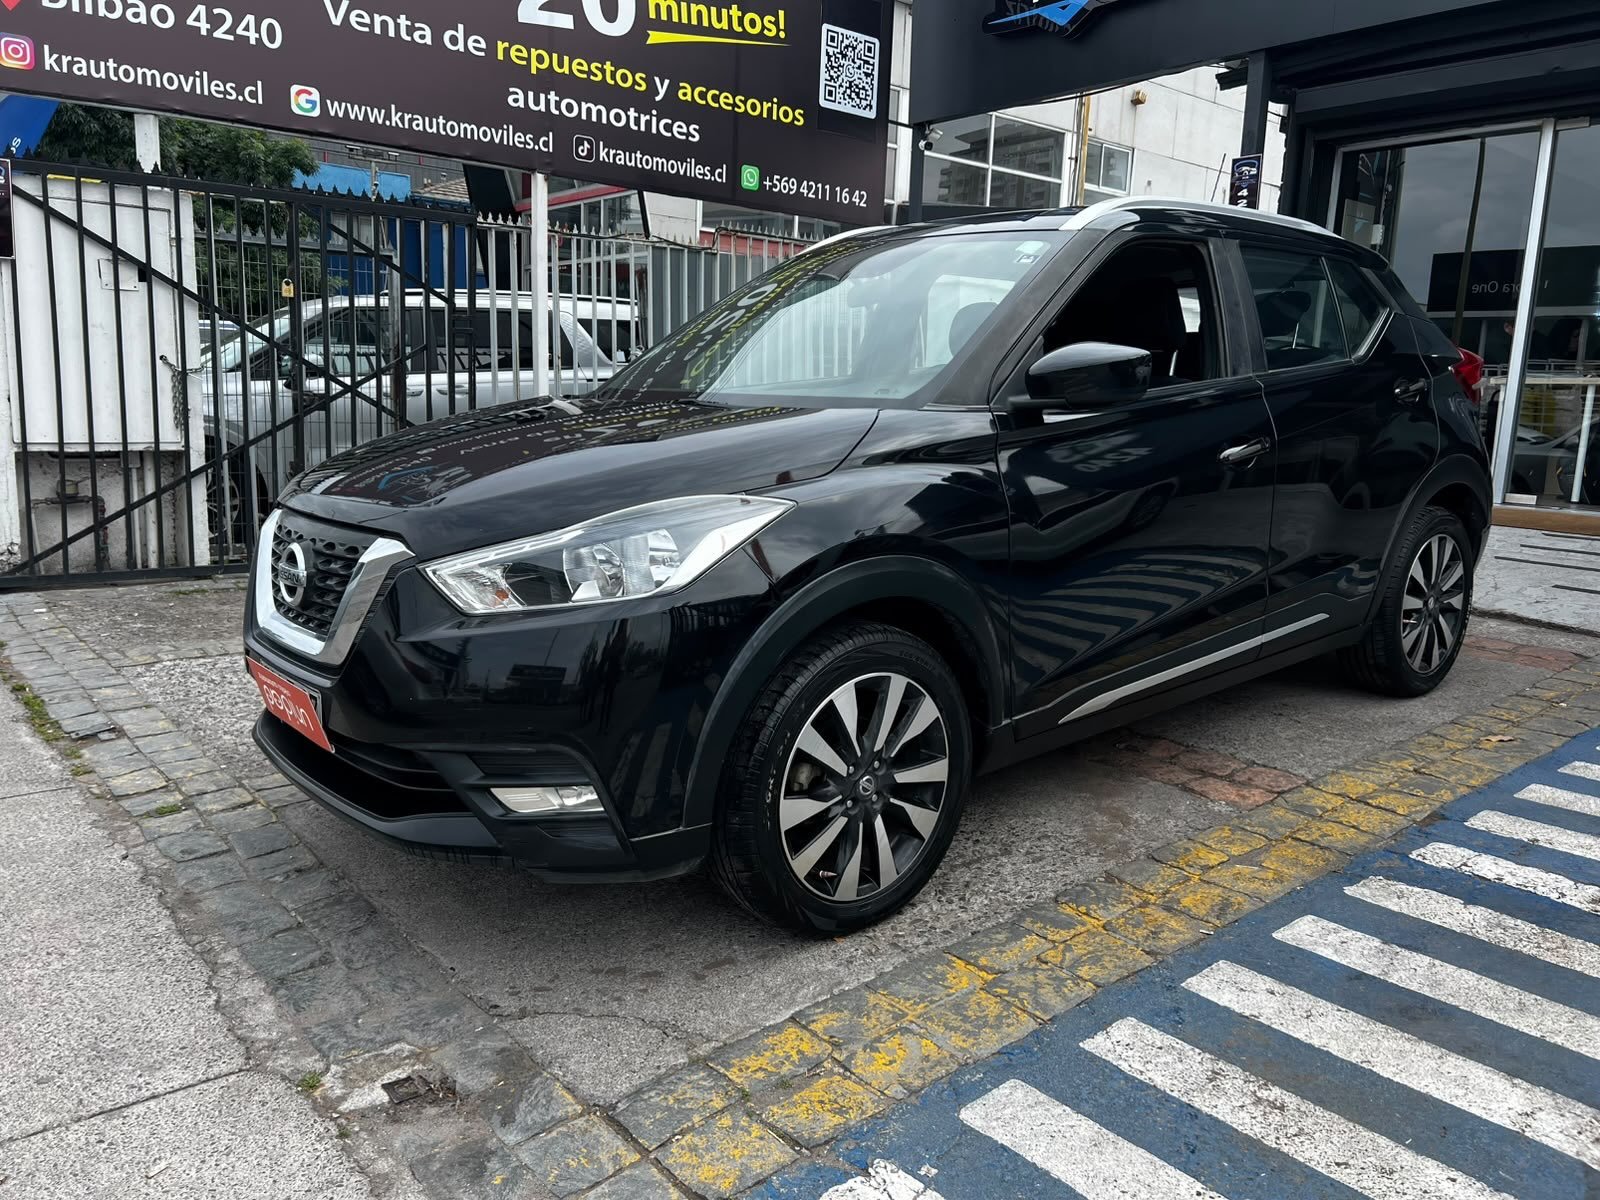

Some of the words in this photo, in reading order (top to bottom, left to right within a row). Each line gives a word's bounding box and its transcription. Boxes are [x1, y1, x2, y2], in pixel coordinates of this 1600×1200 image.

[41, 0, 176, 29] bao
[186, 4, 283, 50] 4240
[647, 0, 786, 39] minutos!
[43, 44, 263, 105] krautomoviles.cl
[324, 0, 432, 46] Venta
[443, 23, 487, 57] de
[496, 40, 646, 92] repuestos
[653, 76, 670, 102] y
[677, 82, 805, 126] accesorios
[326, 98, 553, 153] www.krautomoviles.cl
[507, 87, 700, 142] automotrices
[599, 140, 727, 183] krautomoviles.cl
[762, 174, 798, 196] +569
[800, 179, 831, 201] 4211
[835, 186, 850, 205] 16
[851, 189, 867, 208] 42
